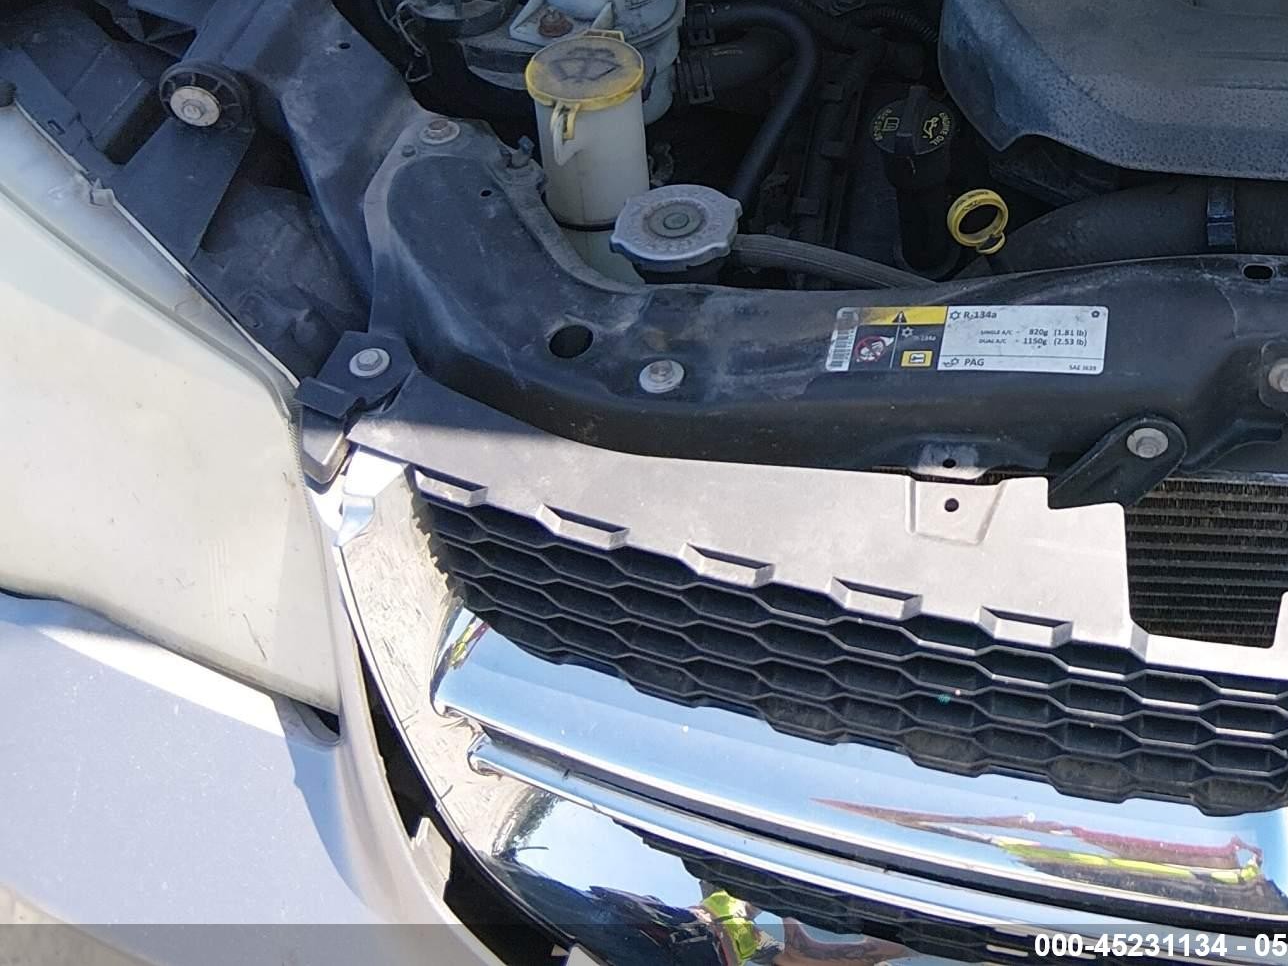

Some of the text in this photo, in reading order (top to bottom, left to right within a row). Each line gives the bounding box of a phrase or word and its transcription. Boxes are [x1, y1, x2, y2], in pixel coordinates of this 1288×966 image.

[1029, 329, 1049, 337] 820g
[1023, 338, 1047, 347] 1150g
[1053, 338, 1074, 347] (2.53
[964, 358, 985, 367] PAG
